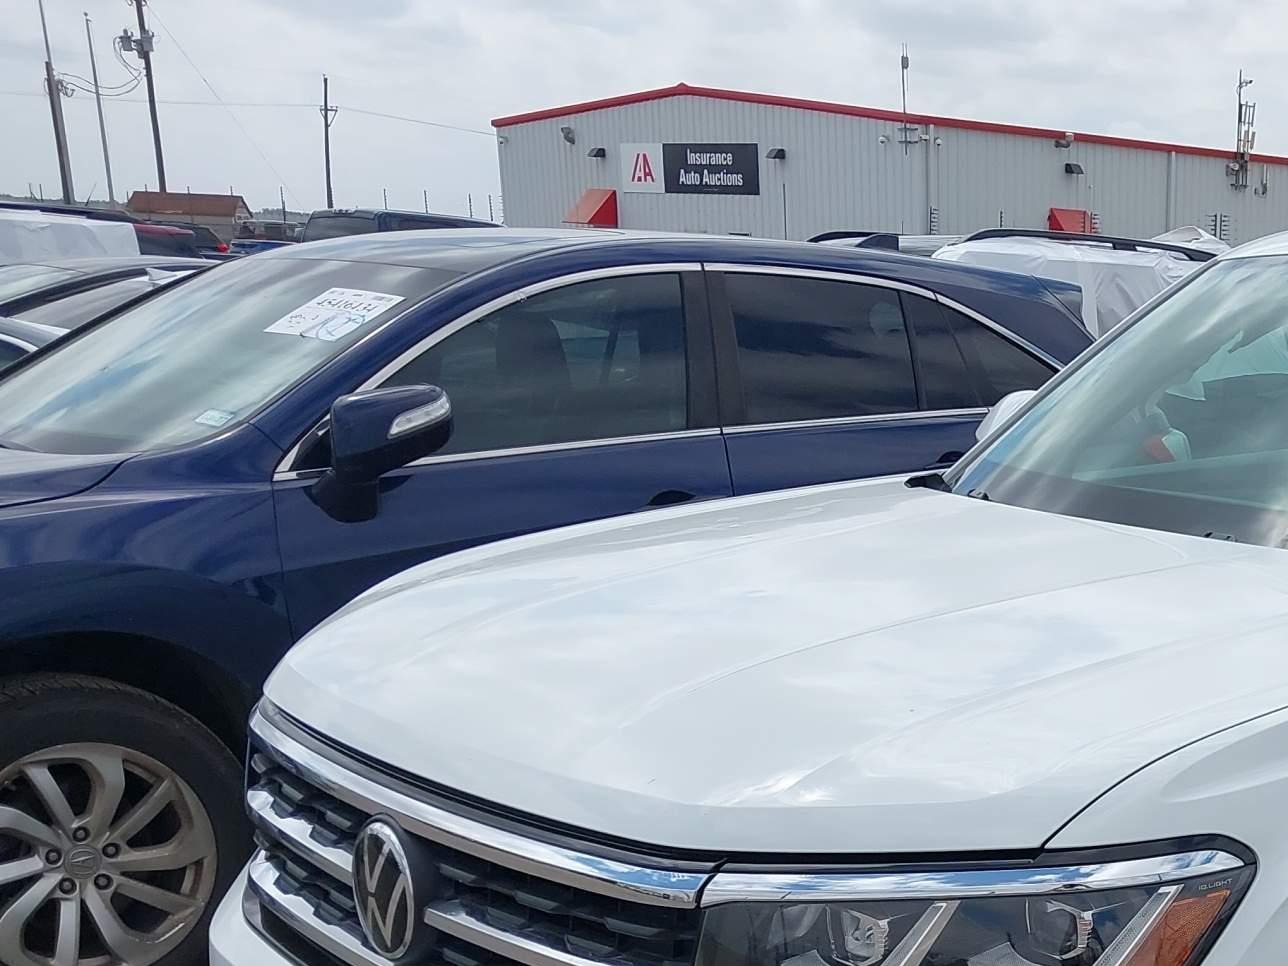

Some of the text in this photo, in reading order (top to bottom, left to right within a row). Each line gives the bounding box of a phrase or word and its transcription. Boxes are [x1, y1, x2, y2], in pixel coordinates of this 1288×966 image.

[687, 148, 733, 166] Insurance
[679, 169, 743, 186] Auto Auctions
